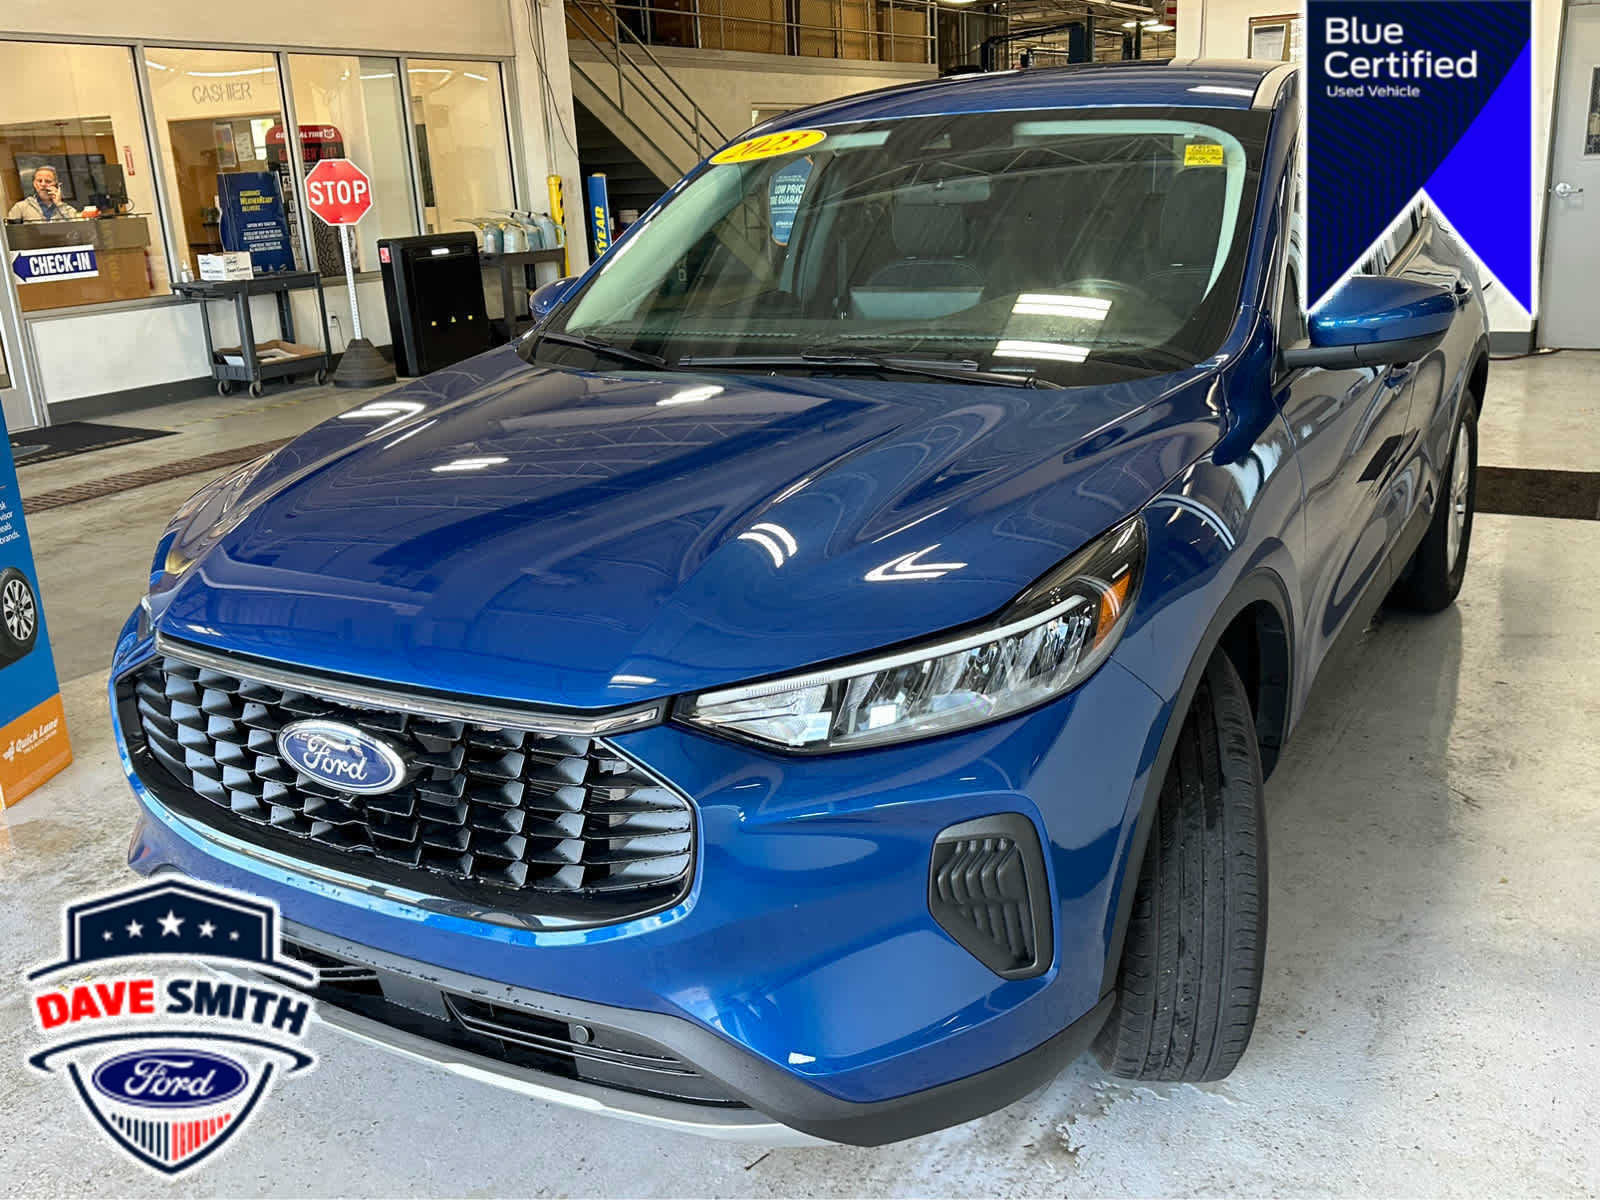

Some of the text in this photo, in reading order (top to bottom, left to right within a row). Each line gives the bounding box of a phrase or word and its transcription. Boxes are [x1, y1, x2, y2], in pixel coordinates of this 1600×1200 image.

[191, 82, 253, 104] CASHIER
[310, 180, 367, 205] STOP
[786, 183, 806, 193] PRIC
[29, 251, 92, 276] CHECK-IN
[15, 728, 39, 753] Quick
[39, 717, 59, 738] Lane
[303, 735, 368, 781] Ford
